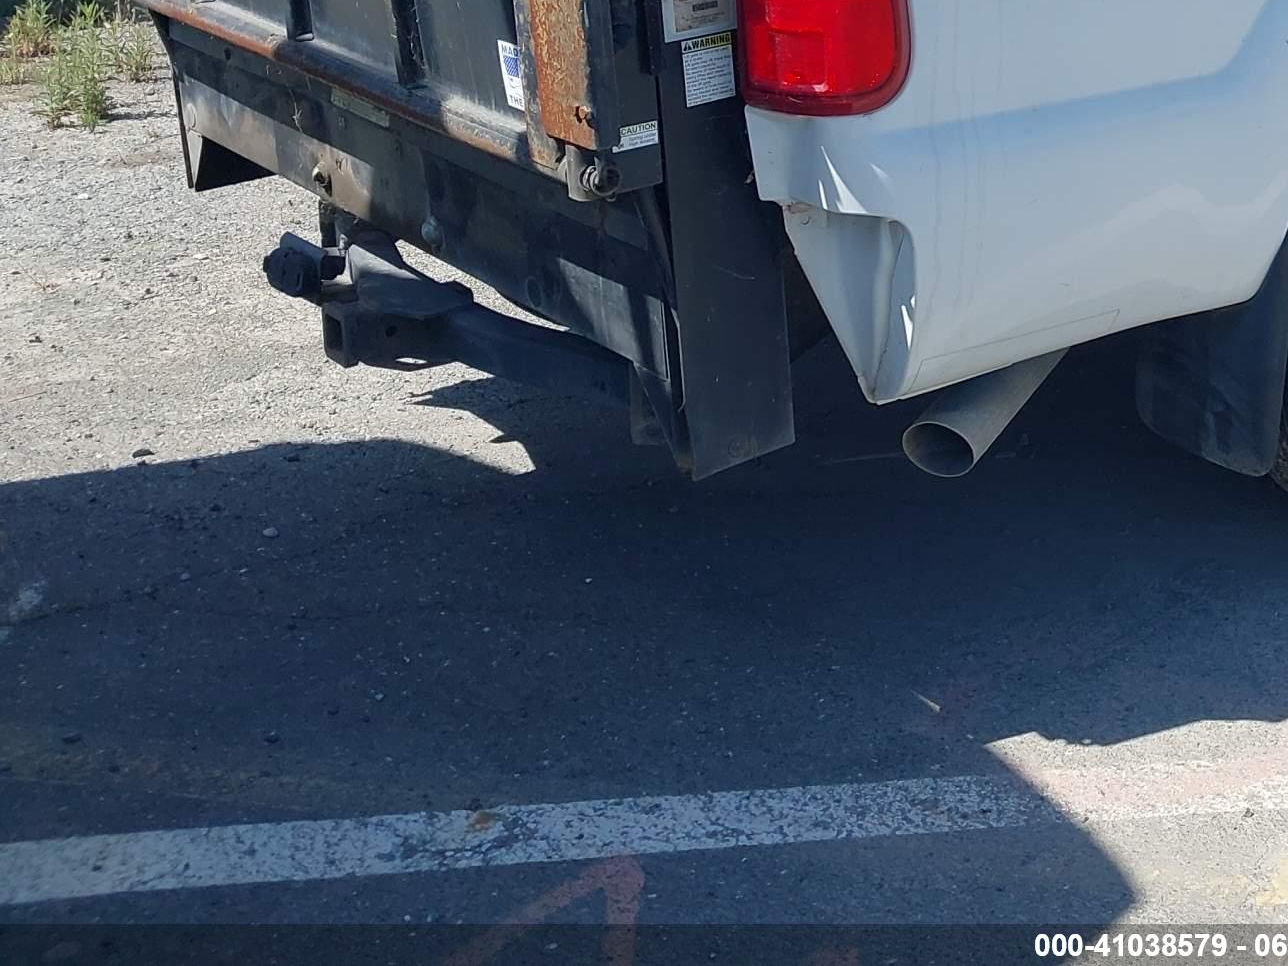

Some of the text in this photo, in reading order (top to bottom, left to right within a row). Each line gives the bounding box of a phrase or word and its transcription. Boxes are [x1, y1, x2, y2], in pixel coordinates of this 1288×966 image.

[691, 33, 731, 50] WARNING
[501, 44, 519, 57] MAD
[621, 121, 656, 136] CAUTION
